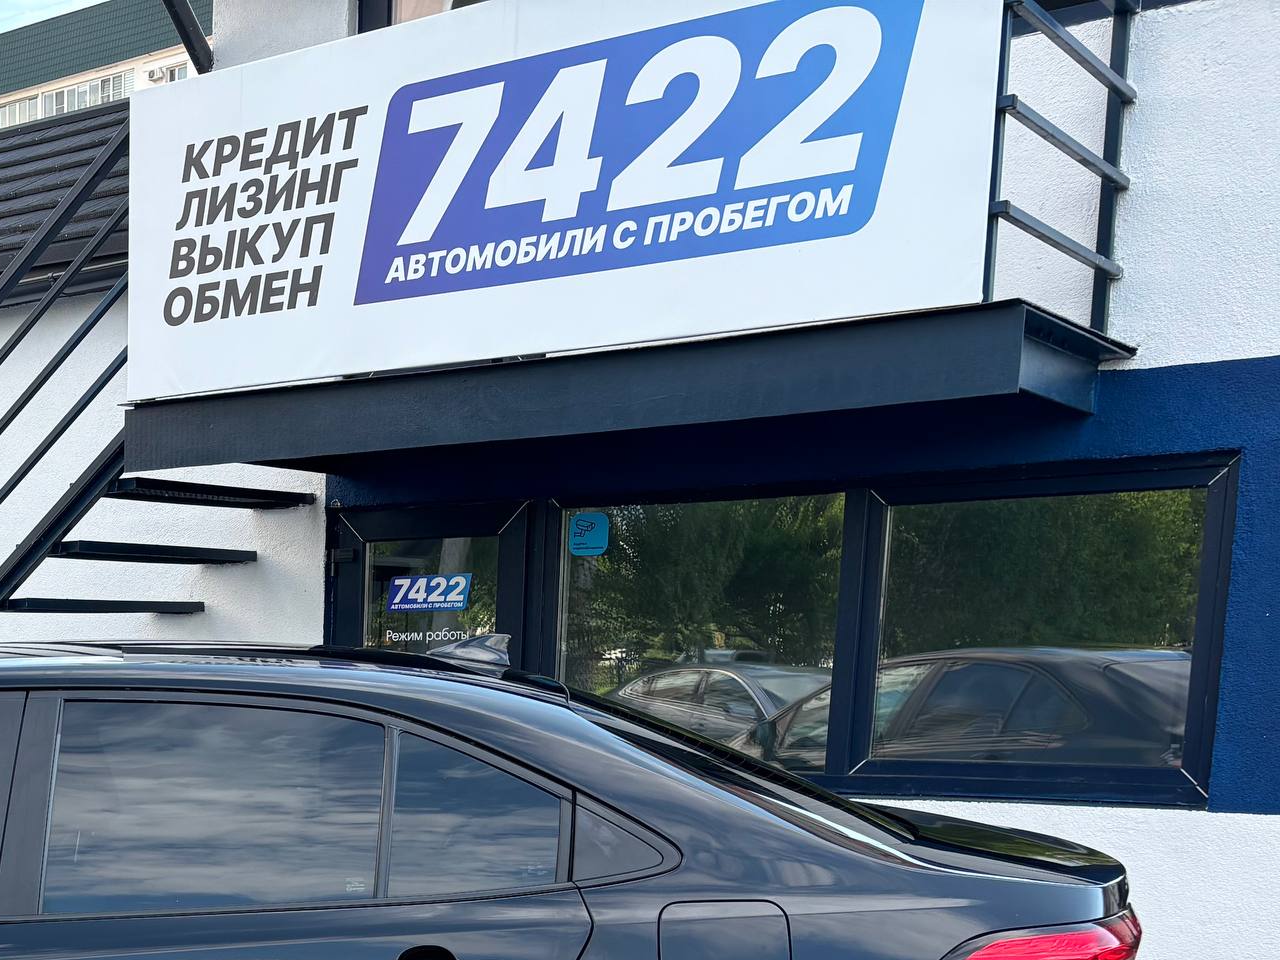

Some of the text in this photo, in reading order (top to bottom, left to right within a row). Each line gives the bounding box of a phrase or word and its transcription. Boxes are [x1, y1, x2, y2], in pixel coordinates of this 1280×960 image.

[182, 105, 368, 183] КРЕДИТ
[397, 6, 881, 245] 7422
[176, 158, 358, 230] ЛИЗИНГ
[169, 213, 335, 279] ВЫКУП
[385, 184, 853, 284] АВТОМОБИЛИ С ПРОБЕГОМ
[164, 265, 322, 326] ОБМЕН
[392, 576, 466, 603] 7422
[386, 627, 470, 644] Режим работы
